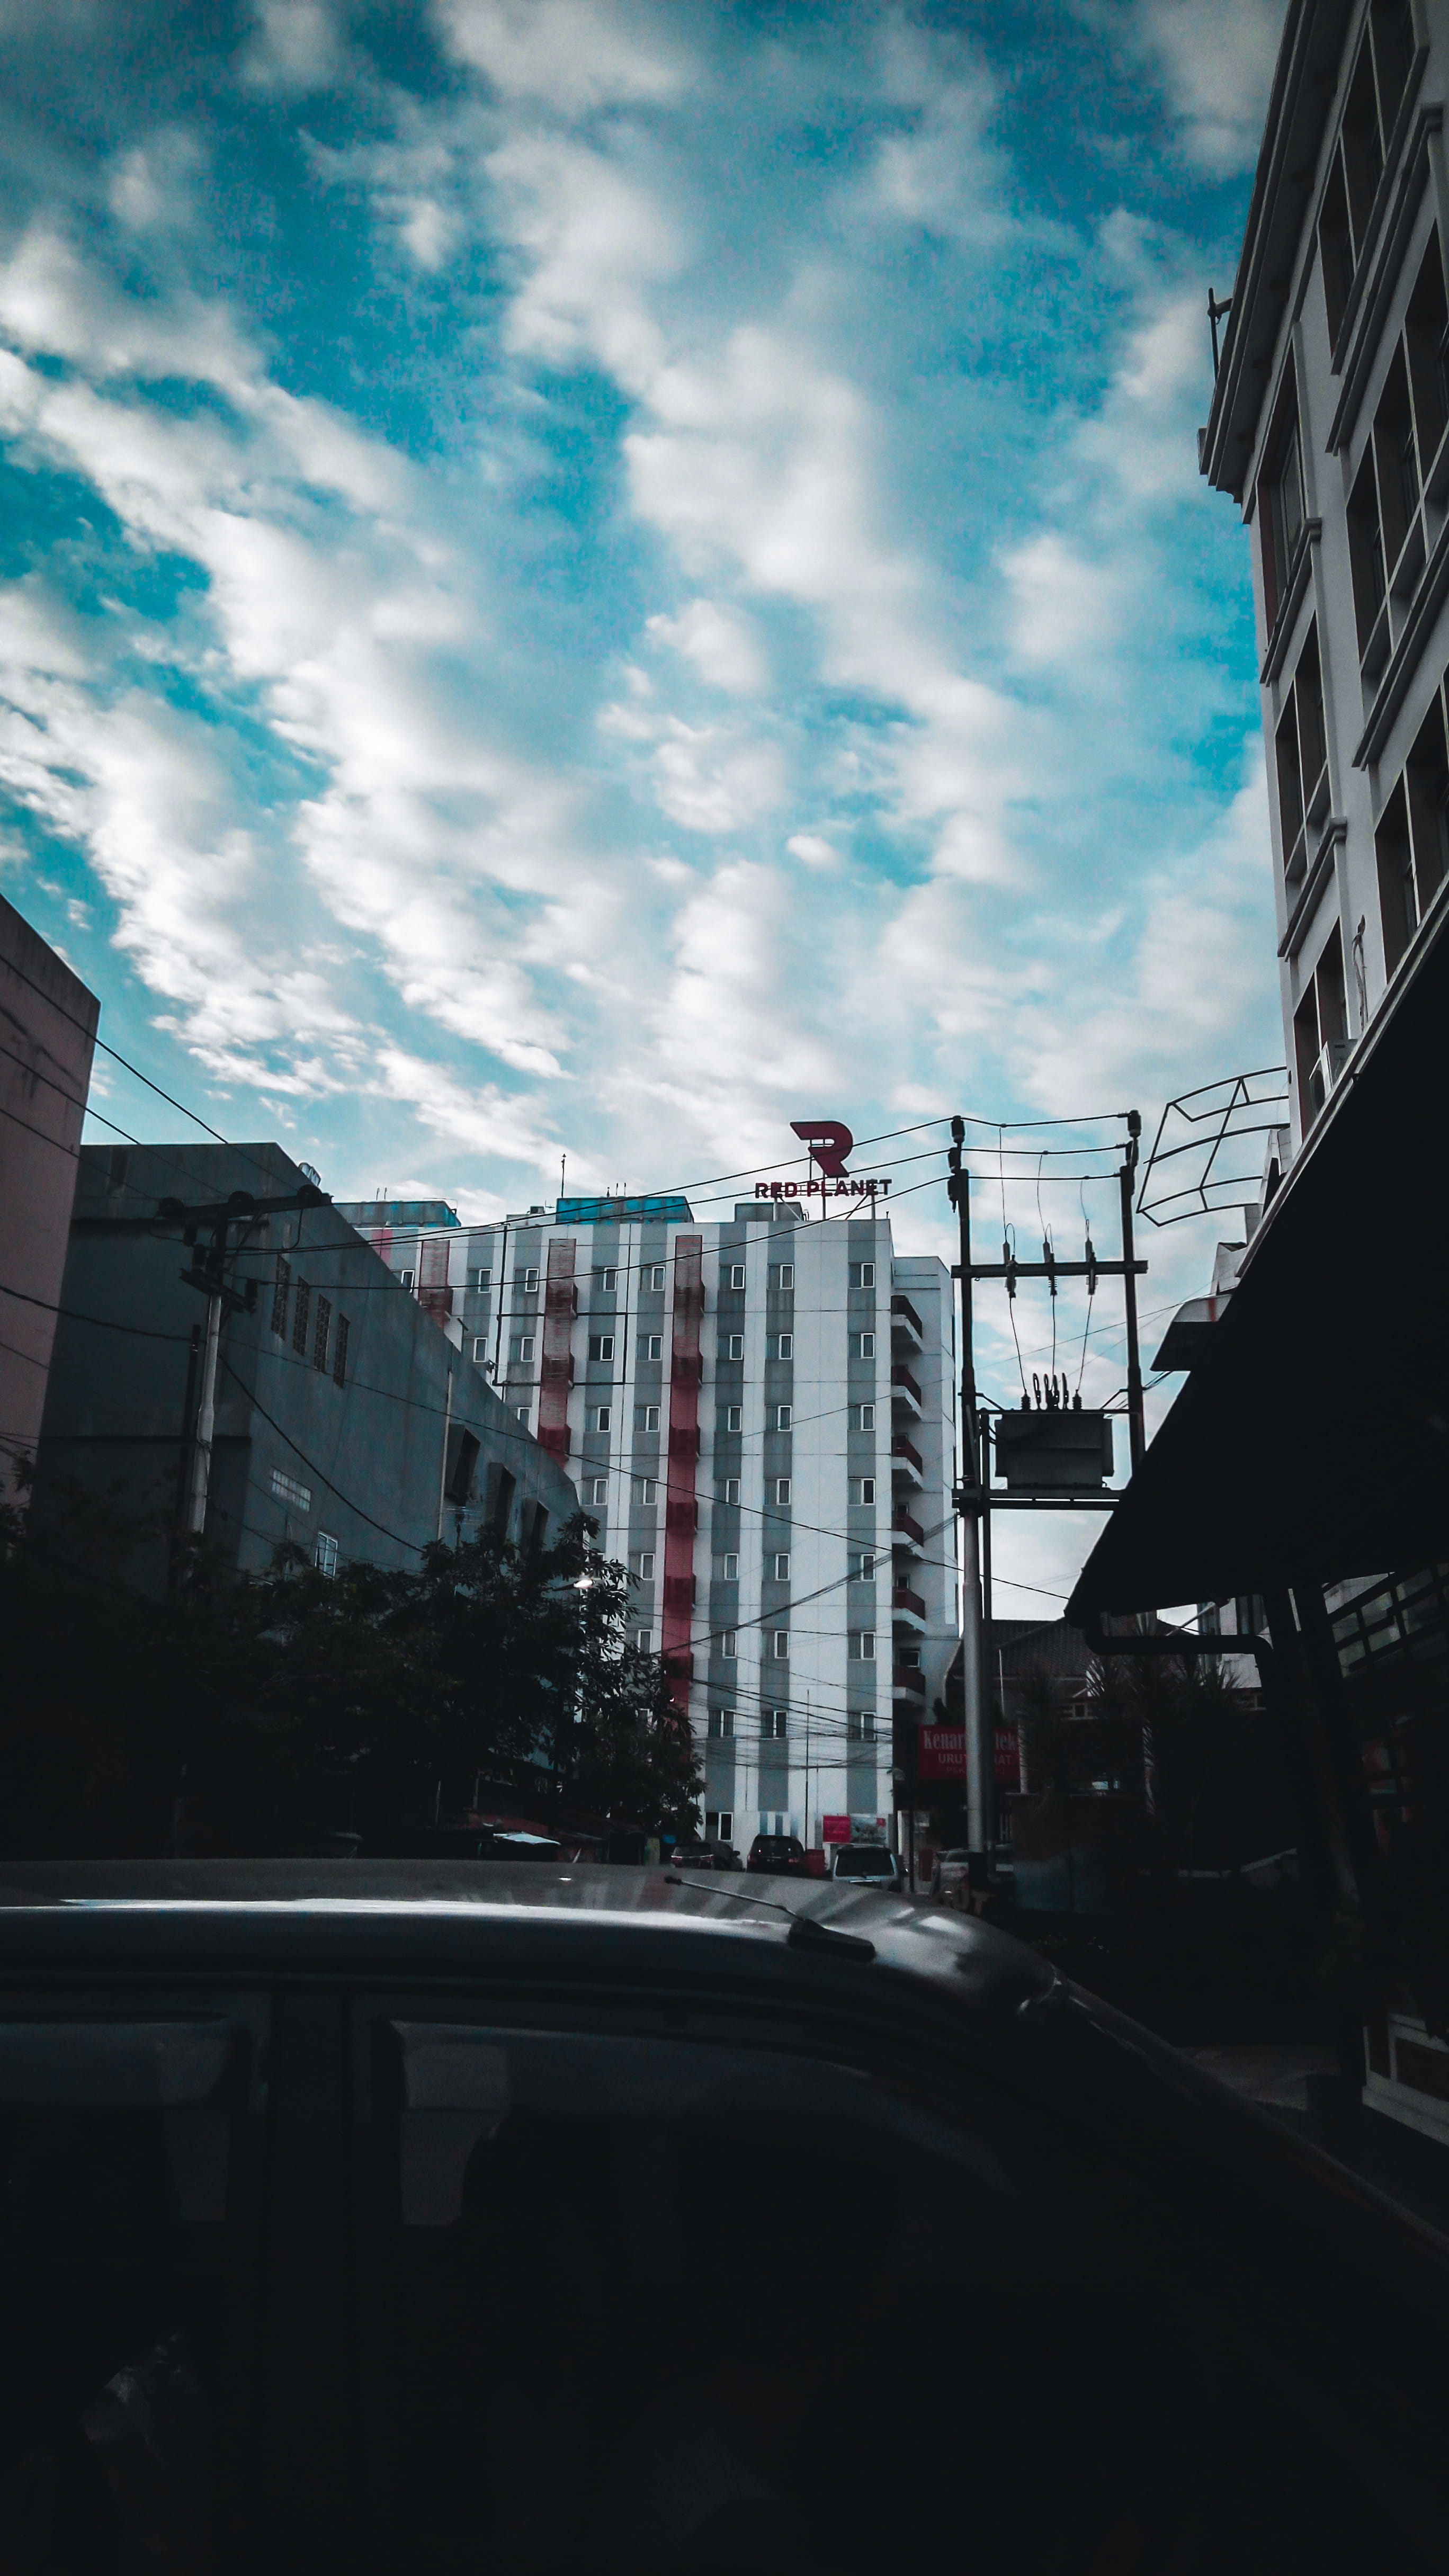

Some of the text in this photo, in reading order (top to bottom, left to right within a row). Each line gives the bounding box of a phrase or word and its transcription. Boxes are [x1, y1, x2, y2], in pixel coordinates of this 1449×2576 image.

[755, 1179, 892, 1198] RED PLANET
[923, 1730, 966, 1750] Kenar
[938, 1753, 967, 1764] URU
